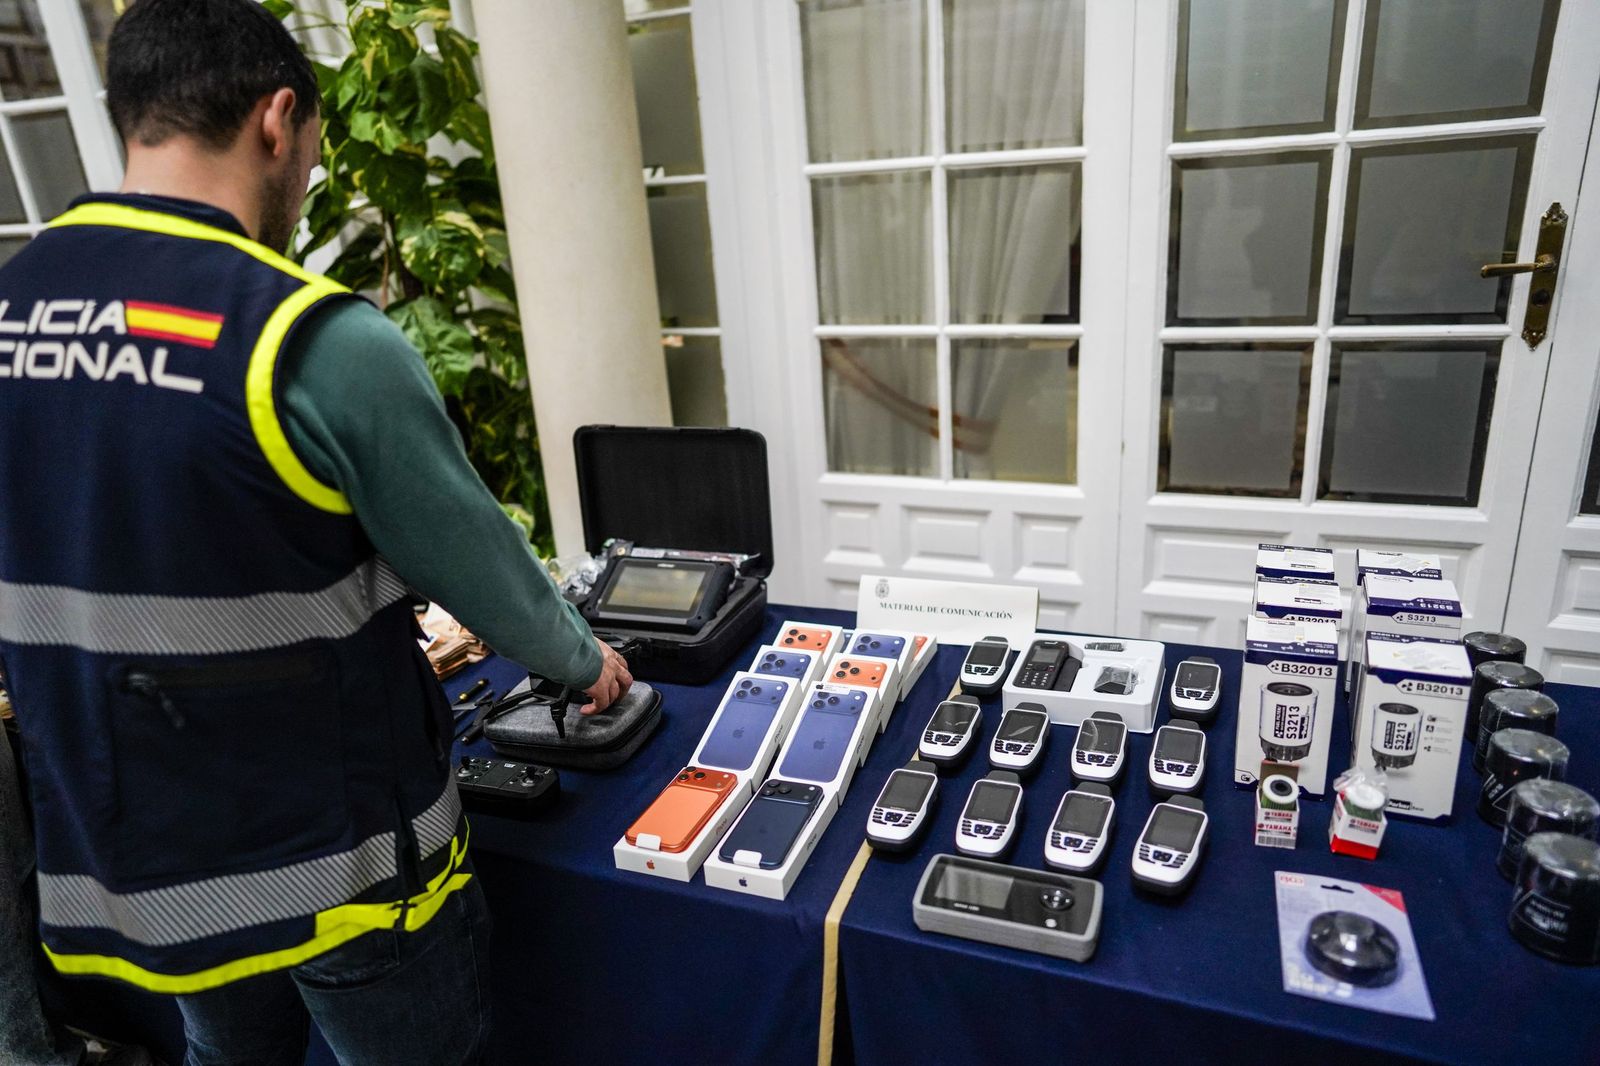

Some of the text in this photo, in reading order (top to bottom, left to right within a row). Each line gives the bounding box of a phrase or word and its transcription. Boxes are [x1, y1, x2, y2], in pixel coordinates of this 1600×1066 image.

[879, 602, 925, 612] MATERIAL
[940, 607, 1013, 619] COMUNICACIÓN
[1407, 613, 1436, 623] S3213
[1281, 662, 1333, 677] B32013
[1416, 682, 1464, 696] B32013
[1286, 706, 1300, 740] S3213
[1394, 722, 1408, 751] S3213
